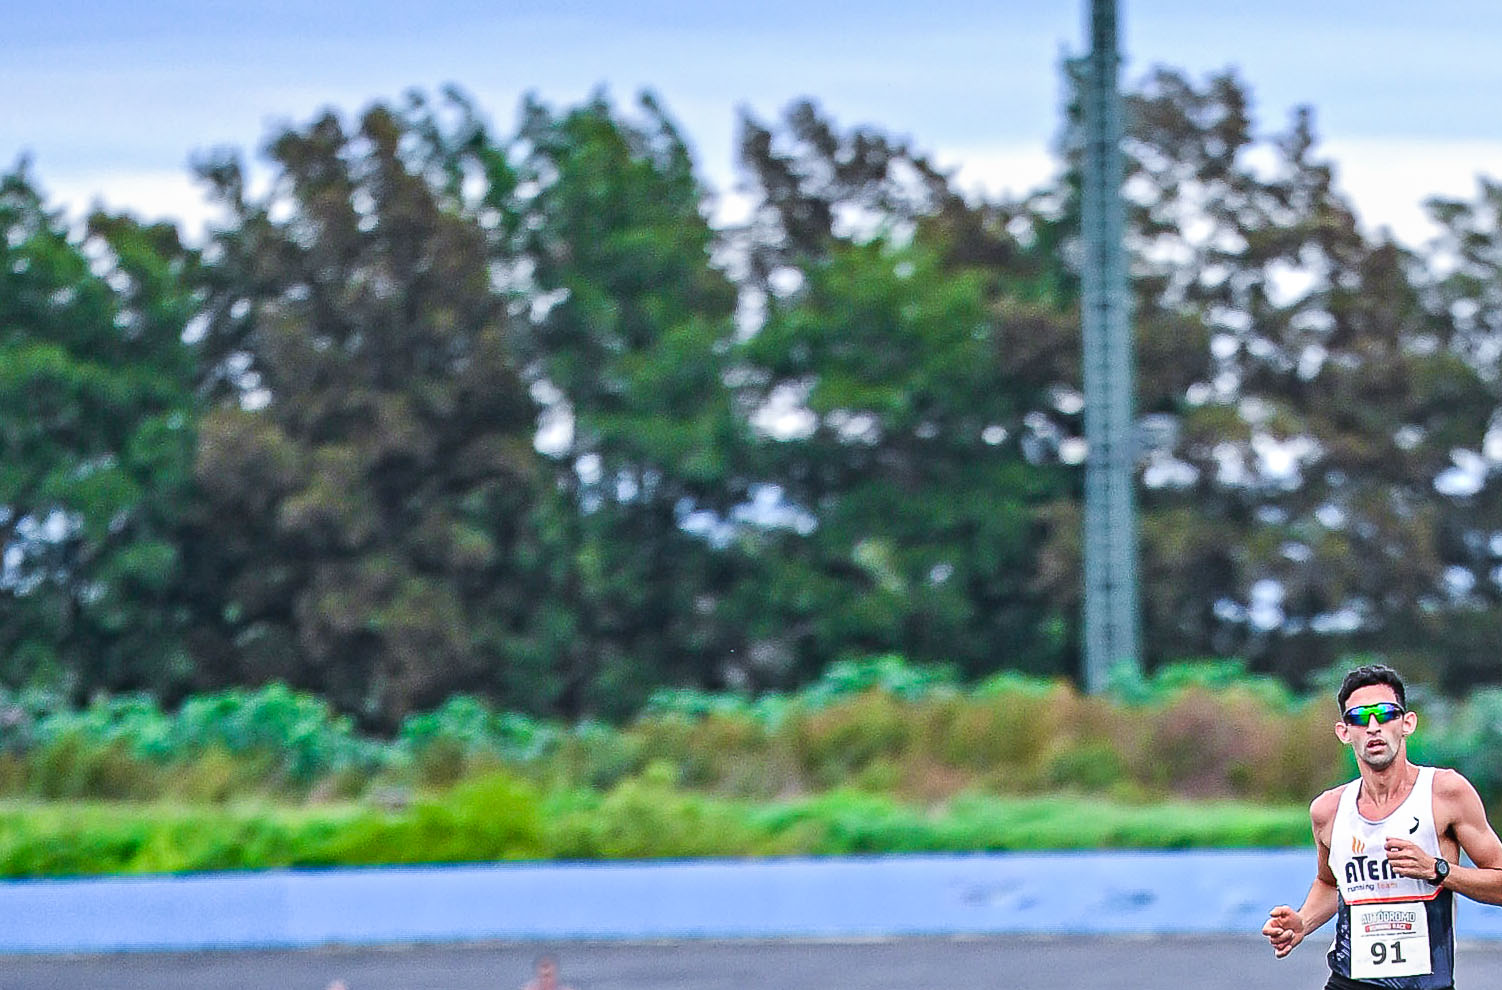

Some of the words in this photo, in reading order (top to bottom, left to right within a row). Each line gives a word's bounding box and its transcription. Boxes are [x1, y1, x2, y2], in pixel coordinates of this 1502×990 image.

[1345, 856, 1405, 883] ATEN
[1347, 884, 1375, 893] running
[1371, 941, 1406, 965] 91
